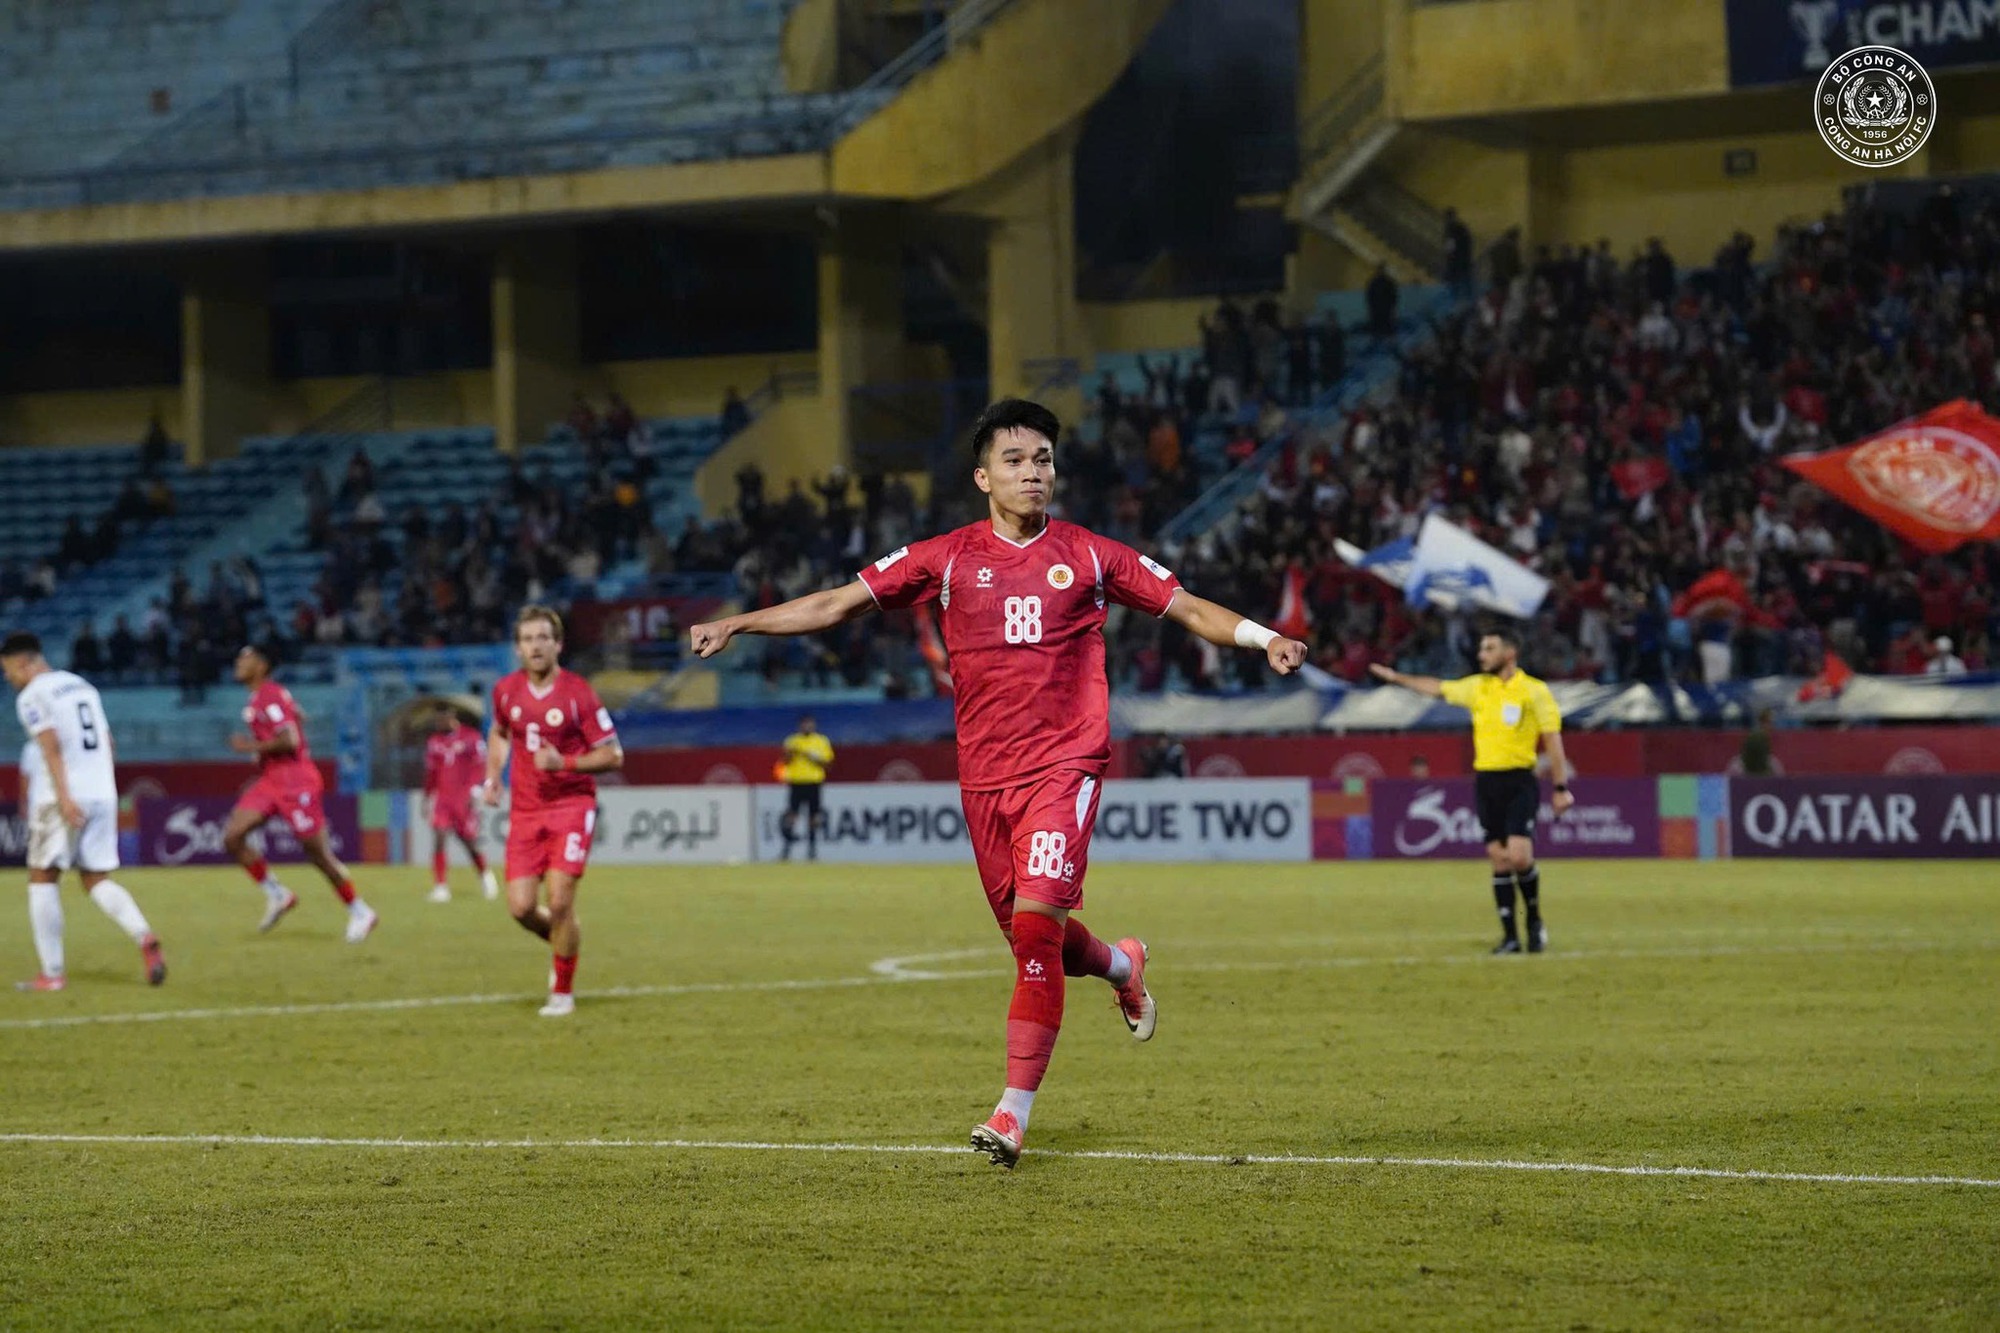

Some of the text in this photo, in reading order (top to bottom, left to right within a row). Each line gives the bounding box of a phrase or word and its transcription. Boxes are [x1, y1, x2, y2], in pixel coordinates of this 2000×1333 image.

[1004, 596, 1042, 643] 88
[78, 702, 98, 750] 9
[526, 722, 541, 752] 6
[779, 805, 968, 842] CHAMPIO
[1094, 803, 1179, 840] GUE
[1194, 802, 1291, 840] TWO
[1743, 793, 2000, 848] QATAR AI
[1028, 831, 1066, 879] 88
